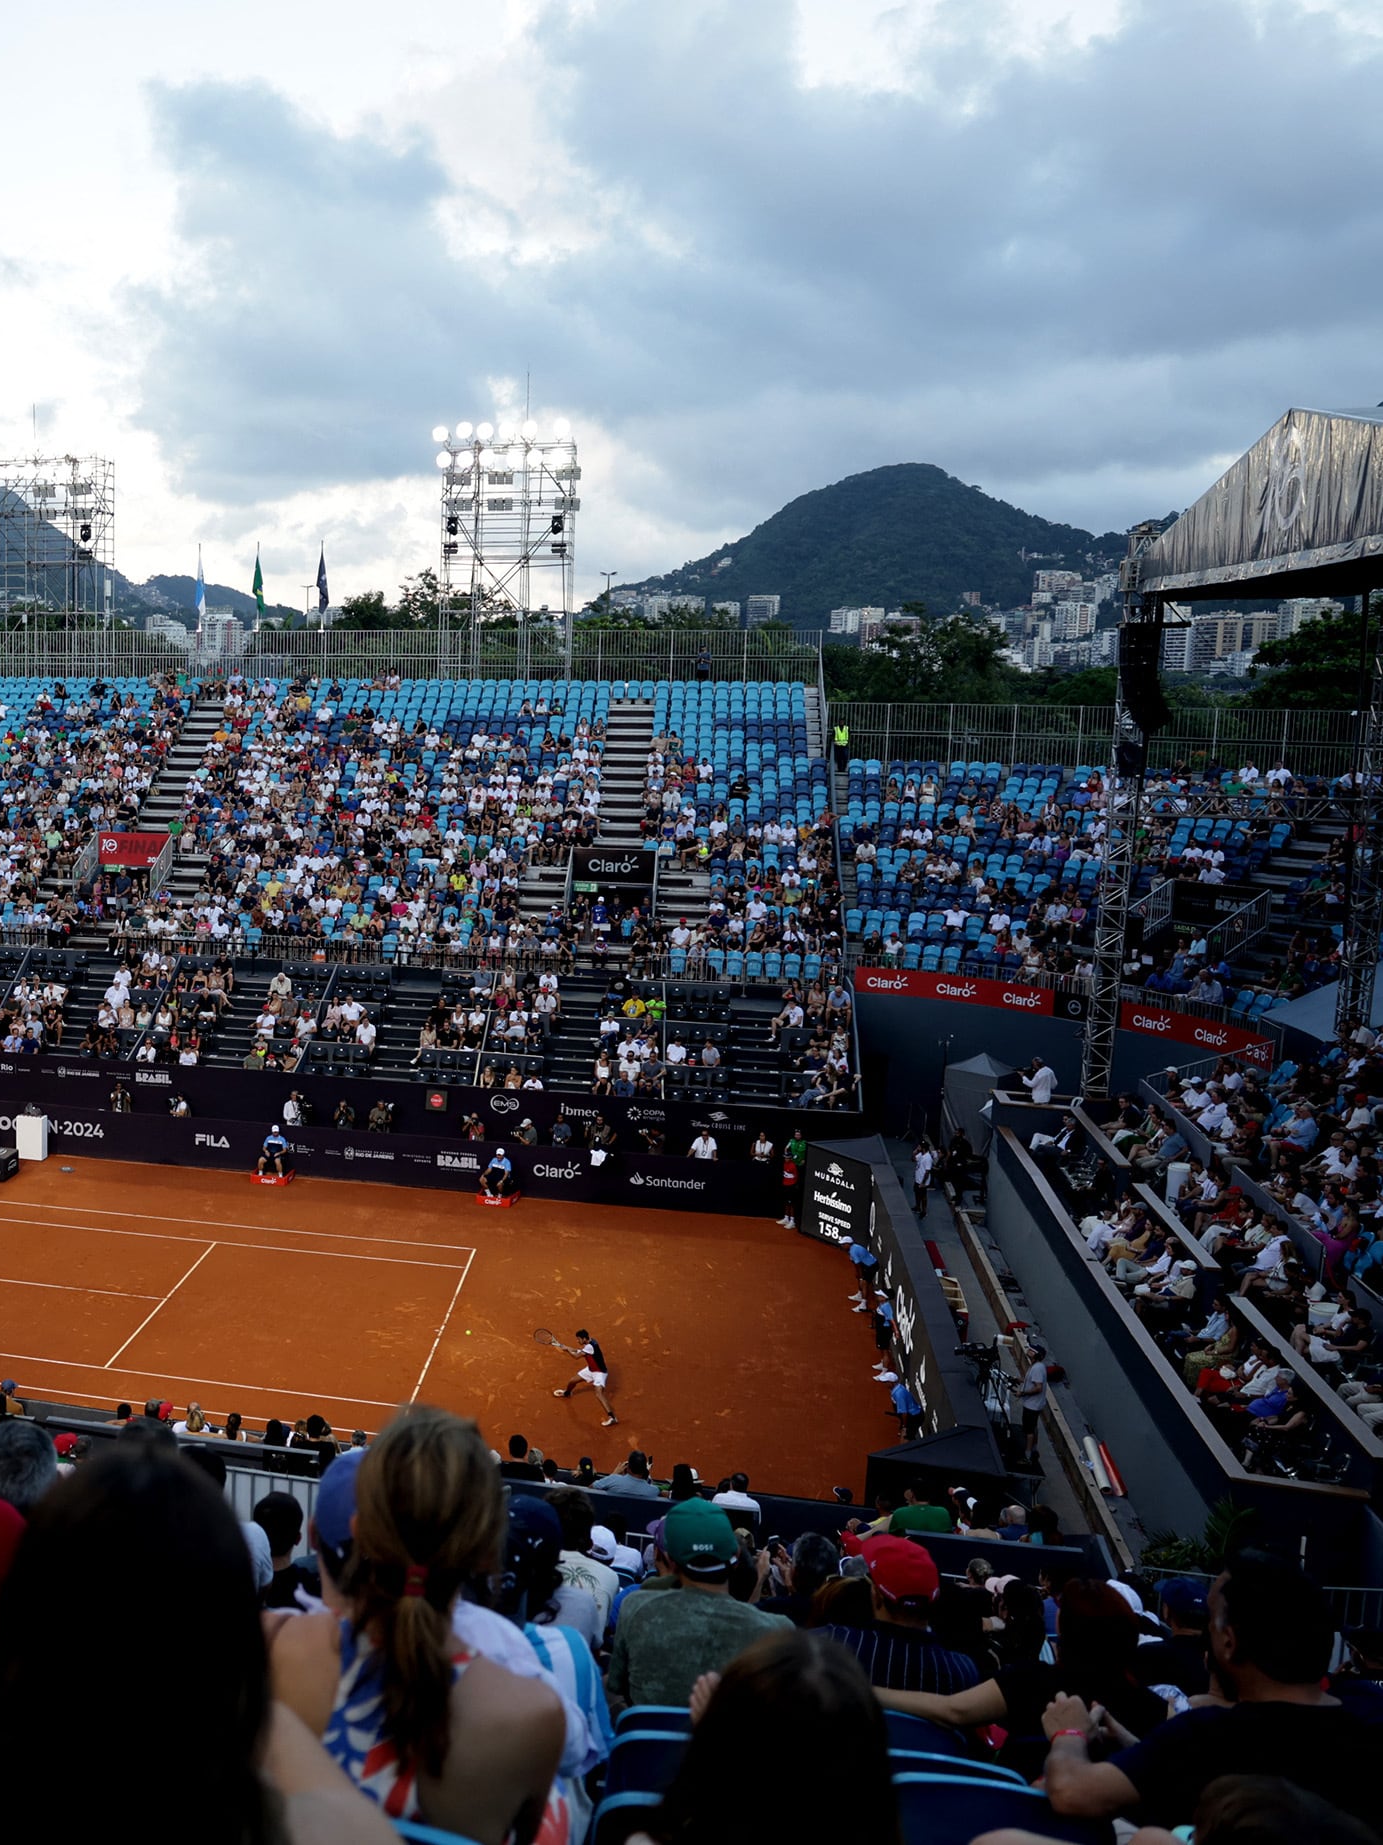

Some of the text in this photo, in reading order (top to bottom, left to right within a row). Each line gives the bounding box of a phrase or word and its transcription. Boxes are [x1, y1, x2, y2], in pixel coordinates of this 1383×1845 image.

[120, 840, 161, 854] FINA
[588, 857, 637, 873] Claro
[866, 976, 906, 989] Claro
[936, 984, 975, 997] Claro
[1003, 993, 1040, 1008] Claro
[1132, 1015, 1169, 1031] Claro
[1194, 1029, 1226, 1046] Claro
[136, 1072, 172, 1084] BRASIL
[493, 1100, 516, 1108] EMS
[560, 1103, 599, 1118] ibmec
[195, 1133, 230, 1148] FILA
[437, 1155, 480, 1170] BRASIL
[533, 1163, 579, 1179] Claro
[646, 1175, 706, 1190] Santander
[815, 1170, 855, 1190] MUBADALA
[818, 1212, 851, 1229] SERVE SPEED
[818, 1222, 839, 1239] 158
